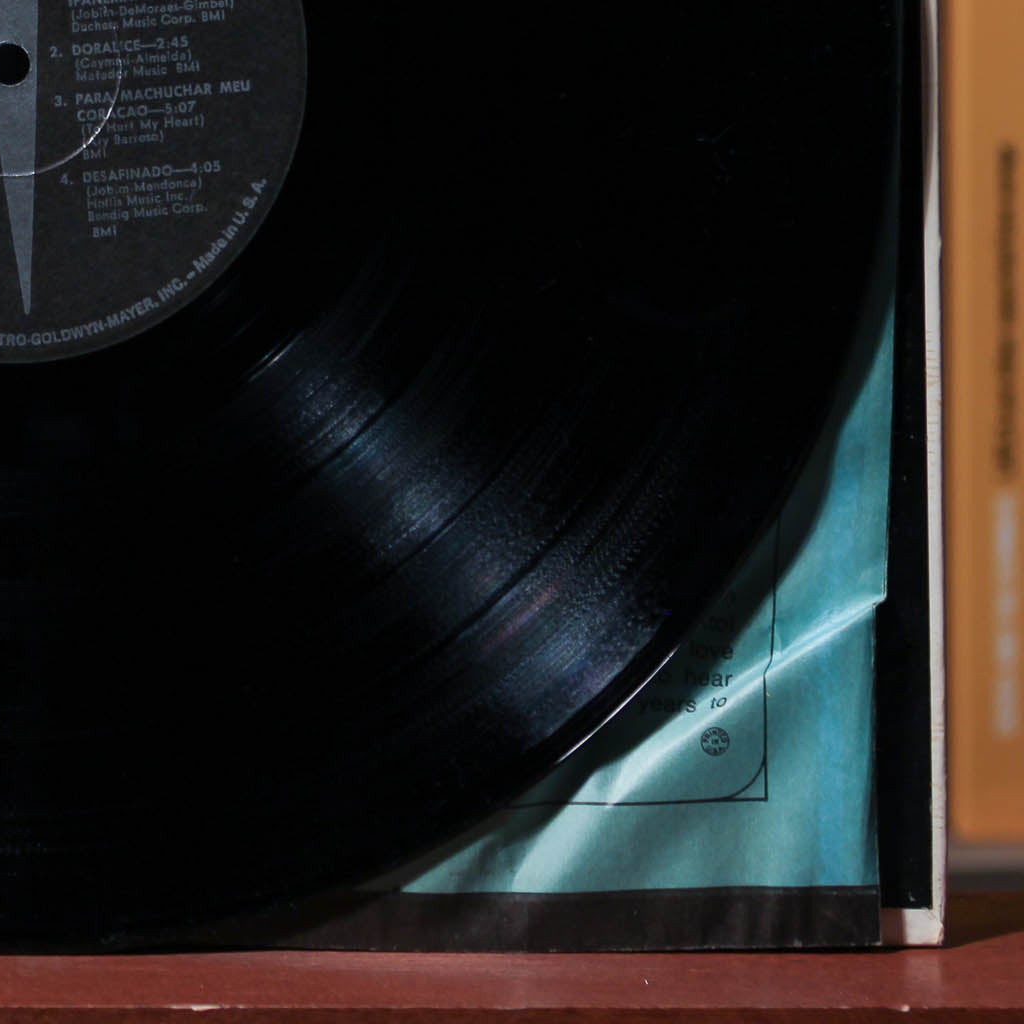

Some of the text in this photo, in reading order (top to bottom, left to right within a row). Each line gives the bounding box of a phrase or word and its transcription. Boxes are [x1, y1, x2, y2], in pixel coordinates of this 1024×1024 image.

[122, 15, 157, 29] Music
[201, 10, 226, 22] BMI
[132, 64, 168, 78] Music
[74, 92, 113, 106] PARA
[120, 82, 213, 102] MACHUCHAR
[219, 79, 252, 93] MEU
[139, 120, 160, 133] My
[163, 114, 206, 128] Heart)
[157, 277, 189, 303] INC.
[192, 237, 228, 274] Made
[686, 670, 734, 687] hear
[711, 697, 727, 709] to
